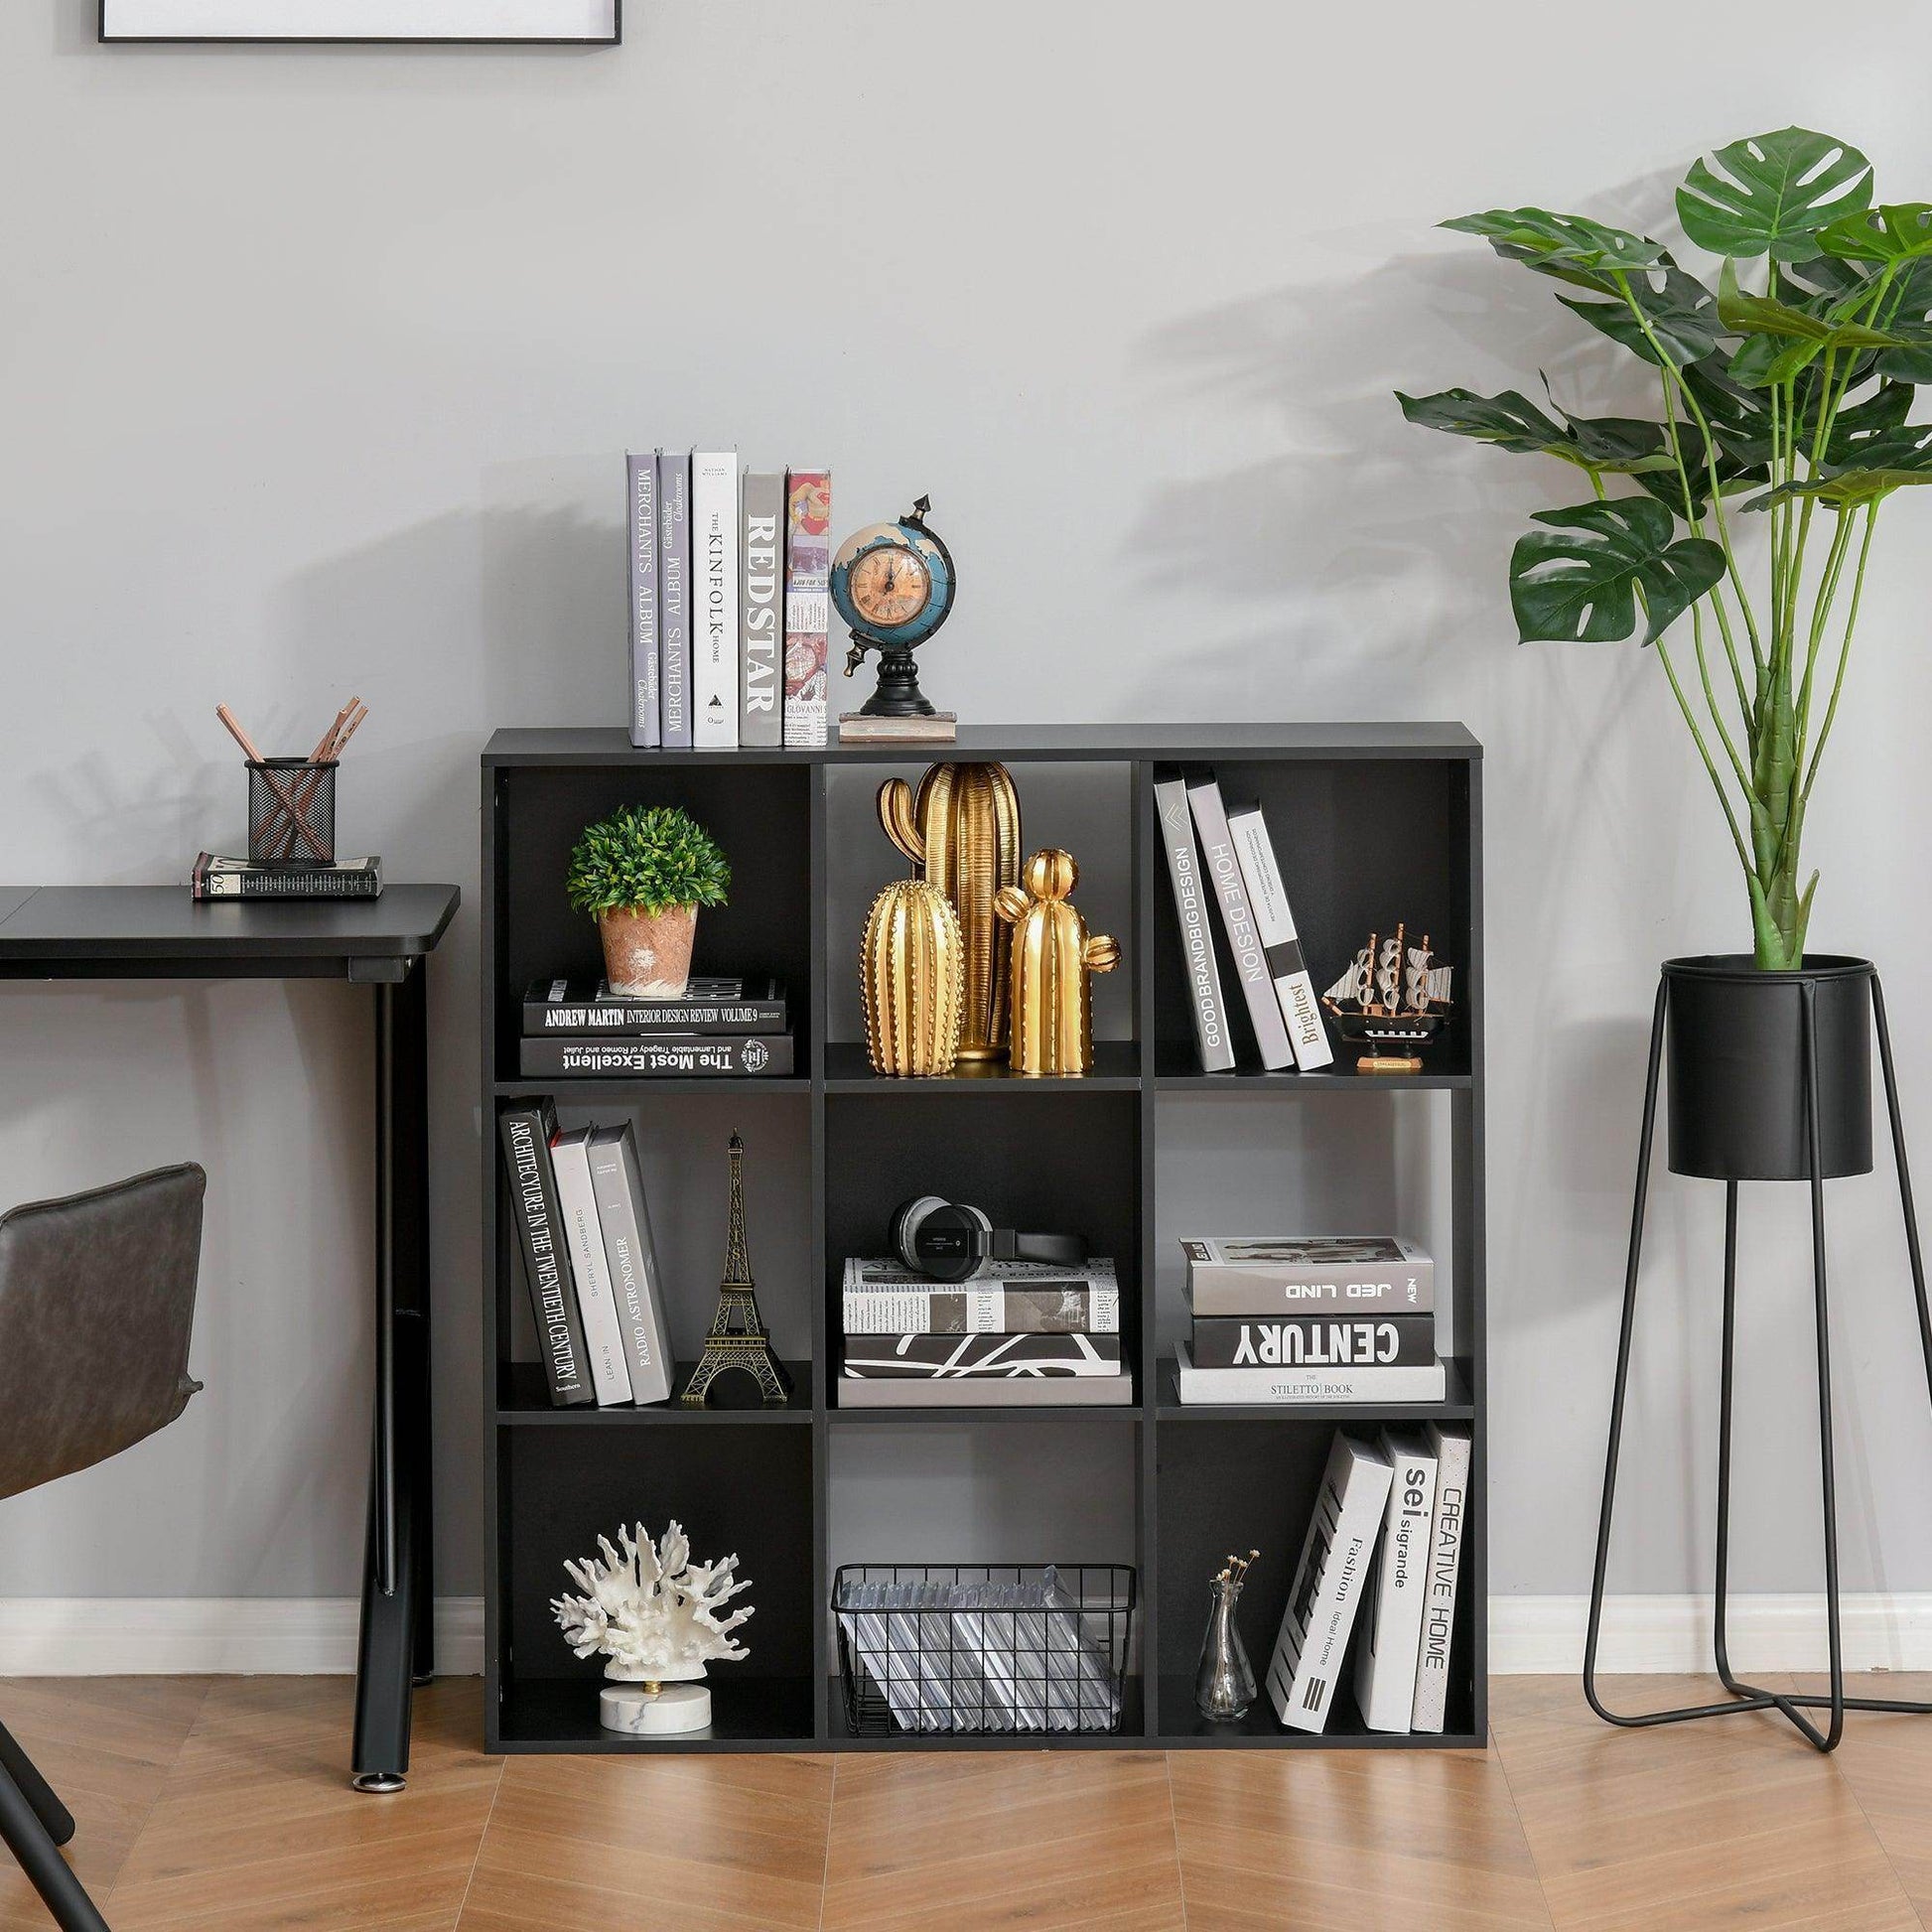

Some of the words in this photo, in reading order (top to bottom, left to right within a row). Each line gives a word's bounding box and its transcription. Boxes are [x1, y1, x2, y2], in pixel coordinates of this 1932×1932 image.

[637, 469, 652, 574] MERCHANTS
[673, 473, 683, 522] Cloakrooms
[667, 556, 681, 616] ALBUM
[709, 534, 724, 635] KINFOLK
[638, 586, 653, 643] ALBUM
[747, 513, 775, 715] REDSTAR
[667, 627, 682, 733] MERCHANTS
[1211, 843, 1241, 904] HOME
[545, 1009, 587, 1028] ANDREW
[588, 1009, 624, 1026] MARTIN
[626, 1010, 661, 1024] INTERIOR
[661, 1009, 690, 1023] DESIGN
[690, 1009, 719, 1023] REVIEW
[1289, 983, 1319, 1045] Brightest
[563, 1053, 645, 1069] Excellent
[639, 1044, 670, 1054] Tragedy
[650, 1053, 694, 1069] Most
[699, 1053, 733, 1069] The
[527, 1212, 548, 1228] IN
[530, 1227, 553, 1253] THE
[575, 1209, 592, 1259] SANDBERG
[535, 1253, 566, 1323] TWENTIETH
[587, 1262, 599, 1298] SHERYL
[617, 1237, 645, 1321] ASTRONOMER
[1285, 1285, 1337, 1299] LIND
[1346, 1284, 1392, 1299] JED
[1407, 1278, 1418, 1304] NEW
[548, 1324, 577, 1379] CENTURY
[630, 1325, 651, 1368] RADIO
[1232, 1322, 1400, 1364] CENTURY
[605, 1358, 615, 1380] LEAN
[1271, 1384, 1319, 1395] STILETTO
[1324, 1384, 1354, 1394] BOOK
[1403, 1467, 1429, 1517] sei
[1394, 1519, 1411, 1588] sigrande
[1432, 1487, 1462, 1597] CREATIVE
[1335, 1538, 1363, 1601] Fashion
[1329, 1610, 1342, 1635] Ideal
[1425, 1606, 1449, 1670] HOME
[1318, 1636, 1335, 1666] Home
